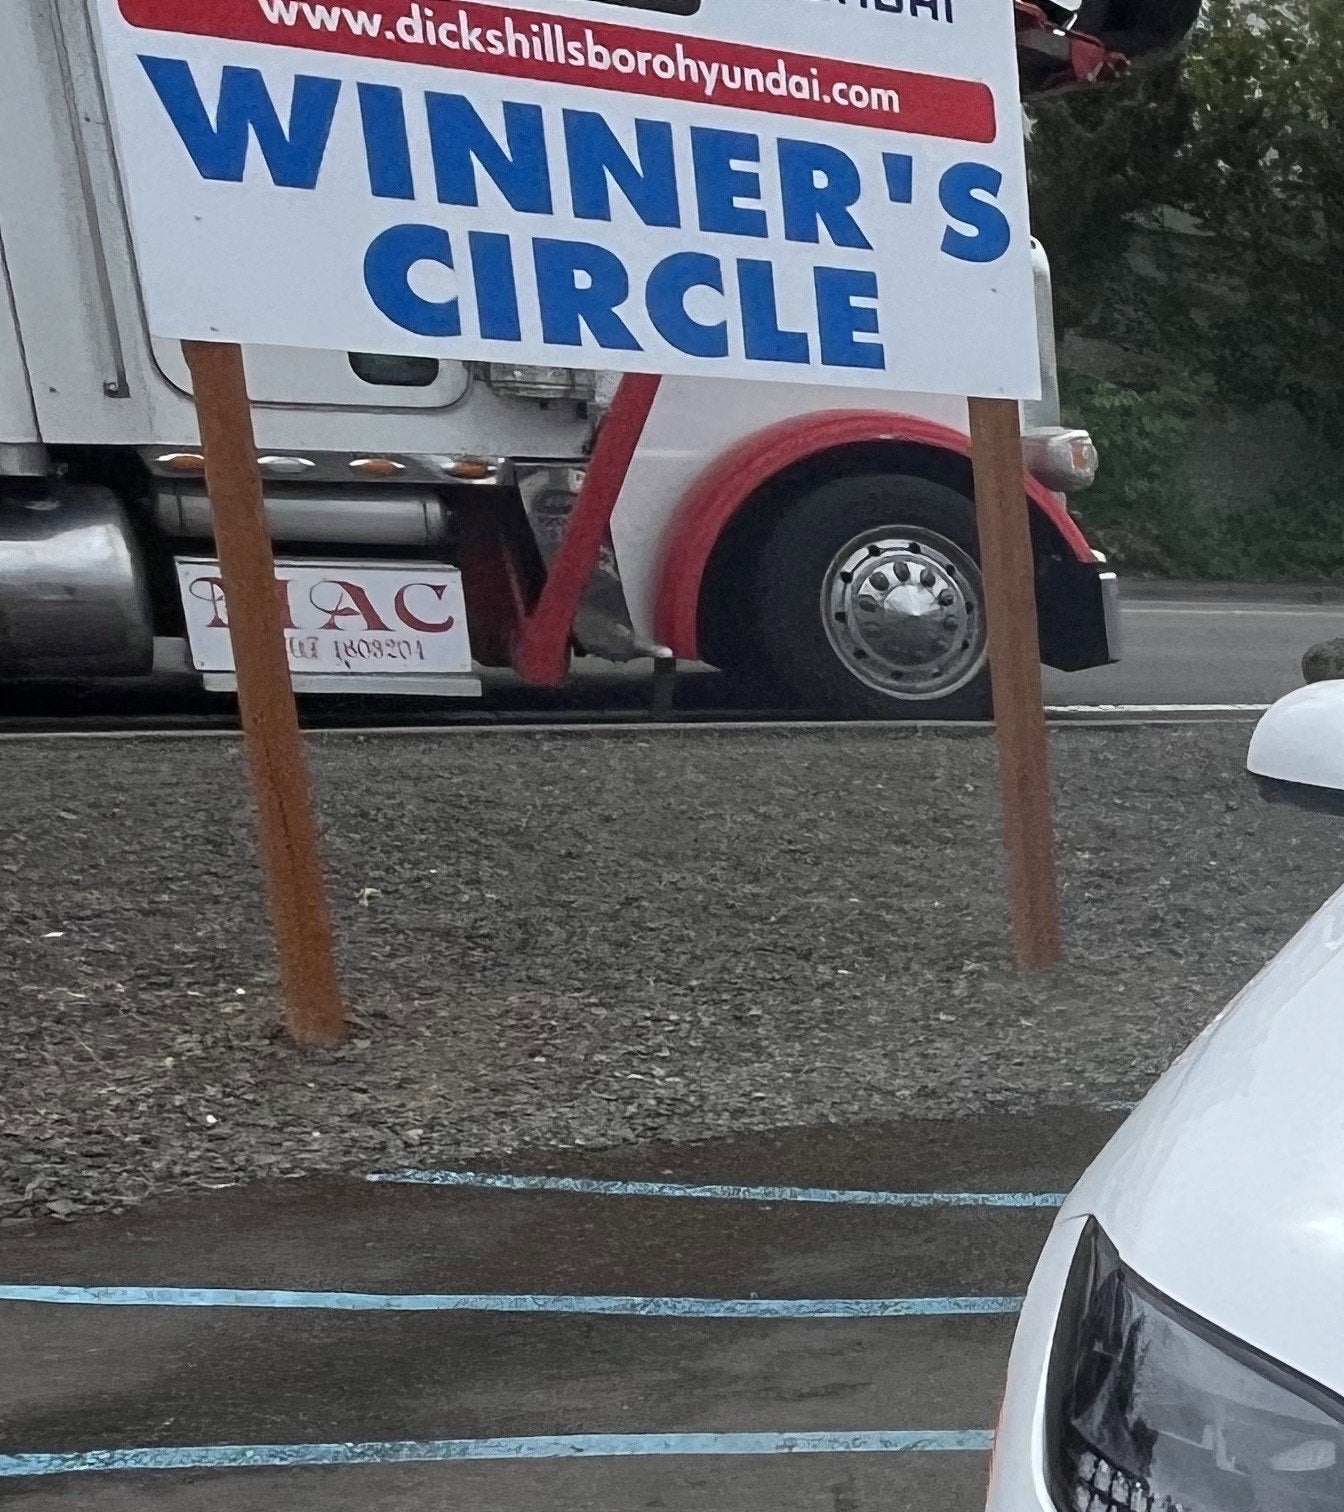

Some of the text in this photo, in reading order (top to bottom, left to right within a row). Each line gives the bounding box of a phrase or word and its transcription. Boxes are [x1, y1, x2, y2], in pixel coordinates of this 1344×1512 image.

[258, 0, 901, 114] www.dickshillsborohyundai.com
[137, 53, 1013, 263] WINNER'S
[363, 223, 886, 371] CIRCLE
